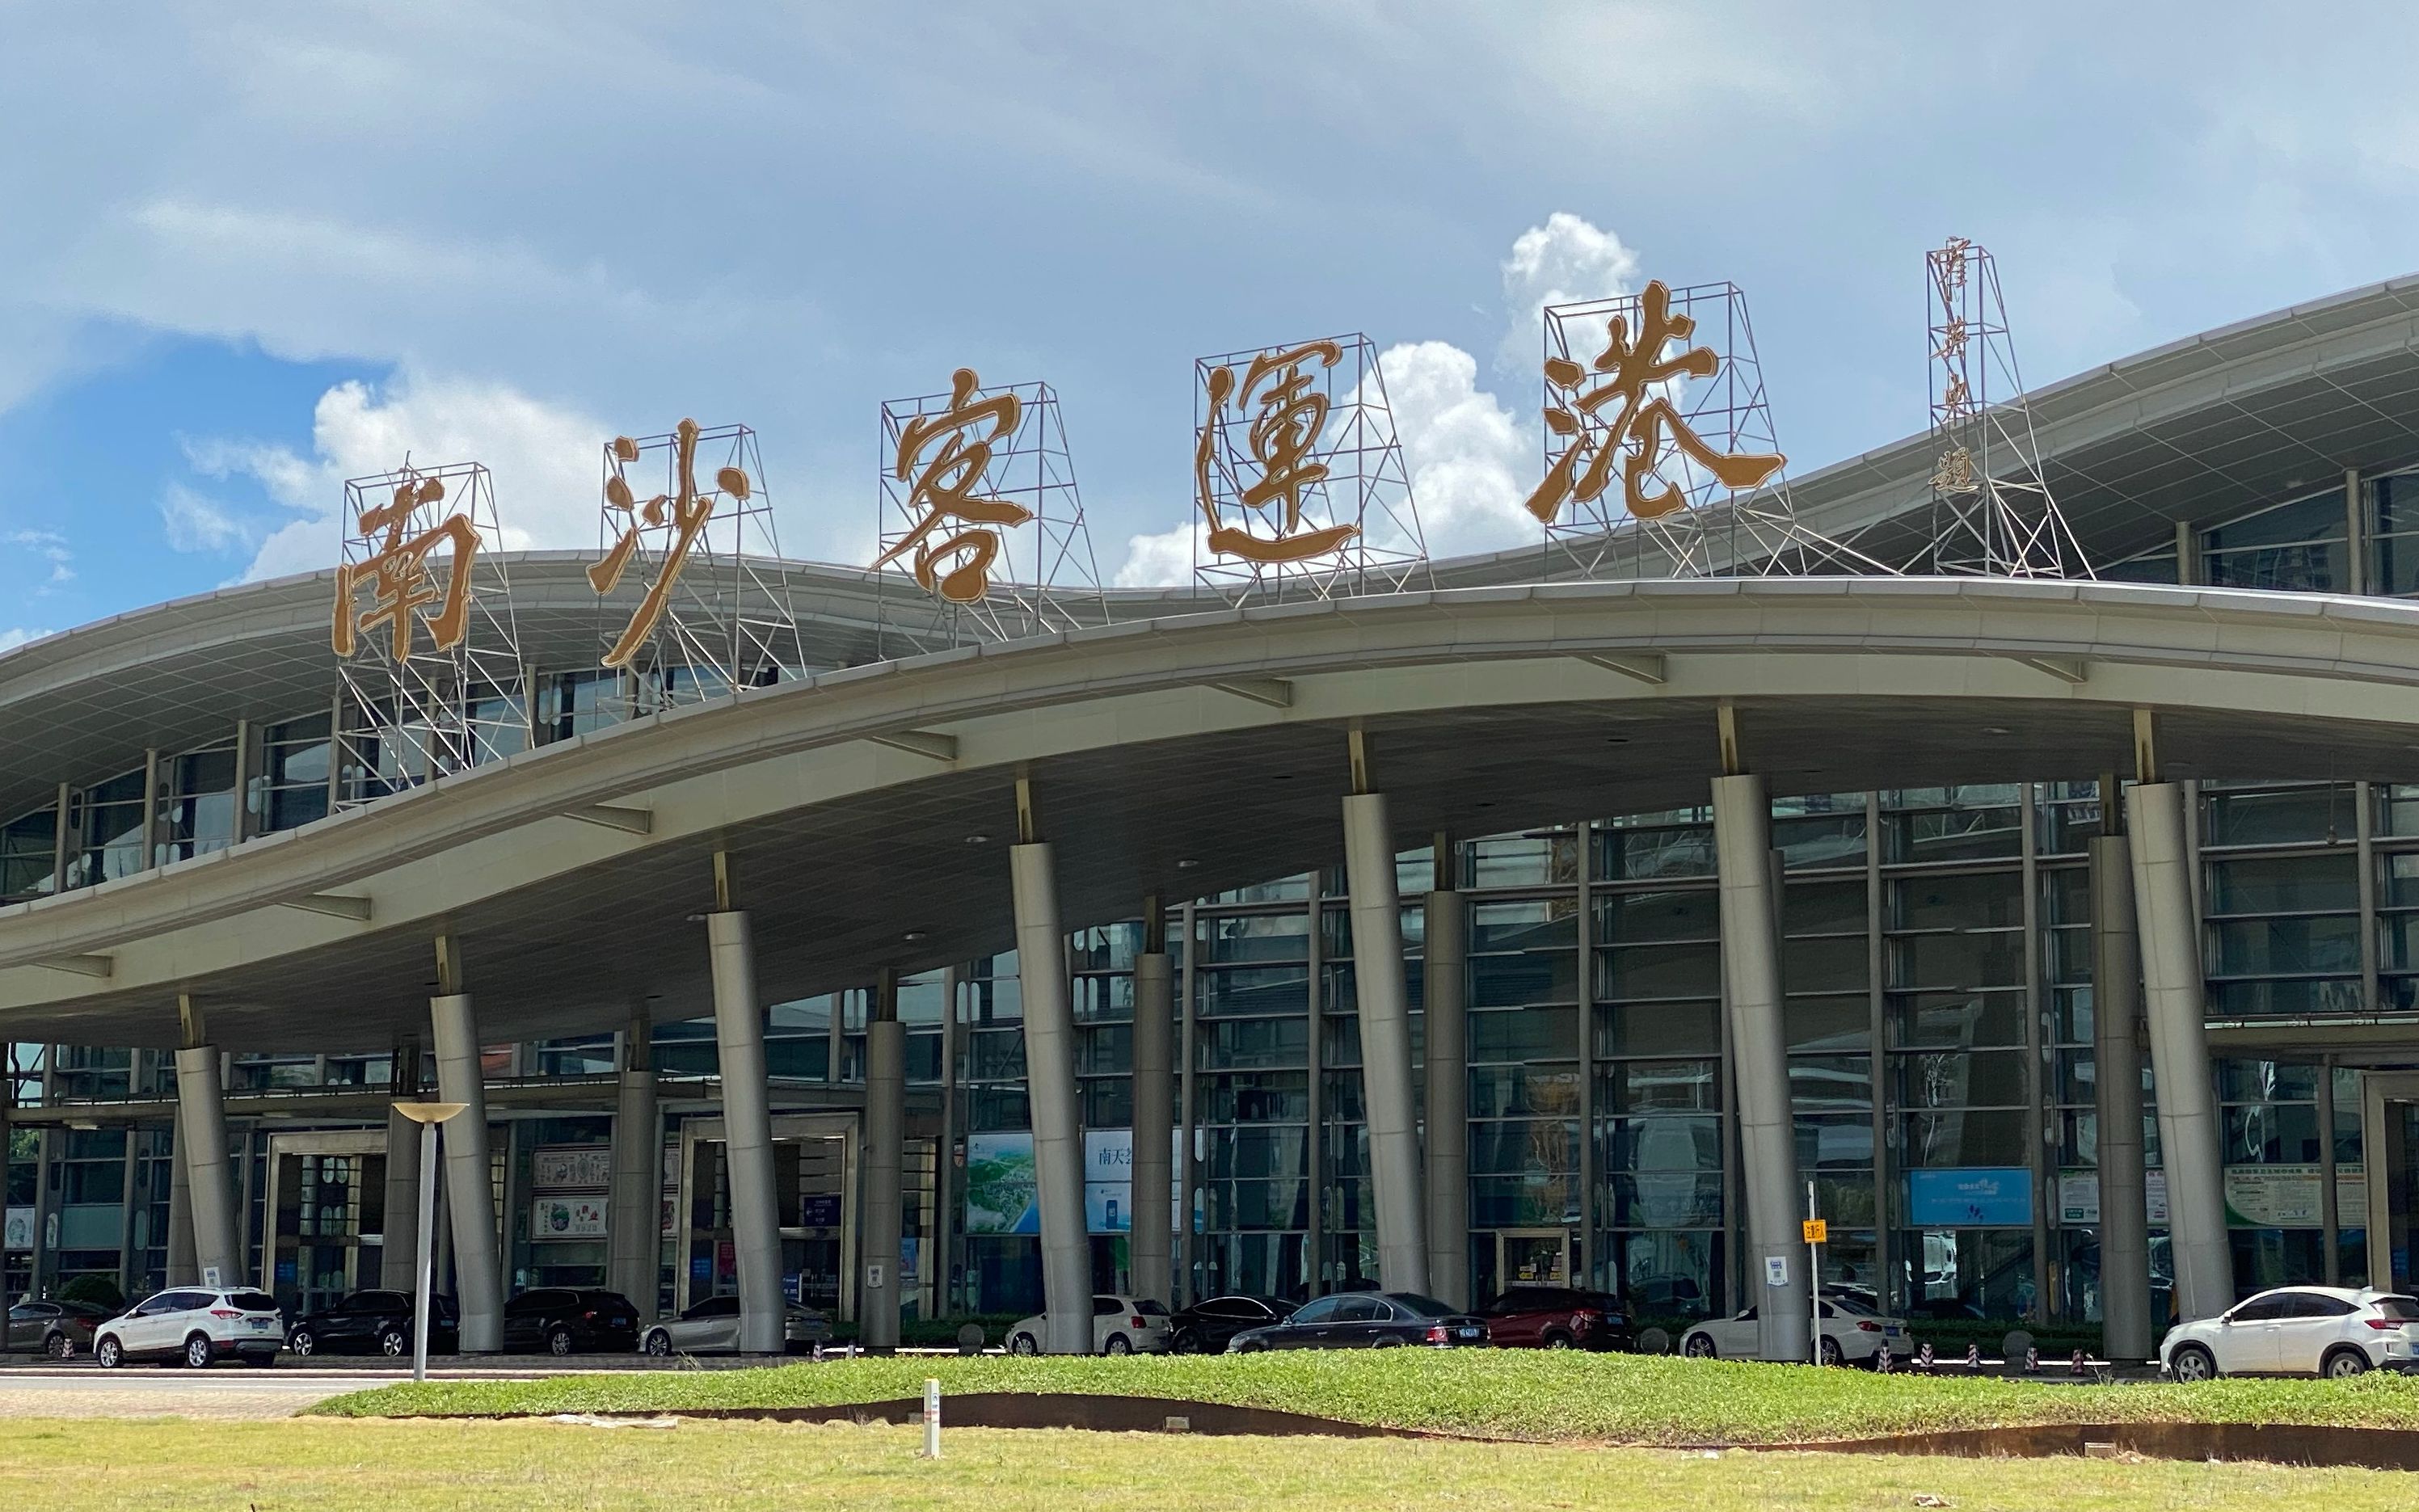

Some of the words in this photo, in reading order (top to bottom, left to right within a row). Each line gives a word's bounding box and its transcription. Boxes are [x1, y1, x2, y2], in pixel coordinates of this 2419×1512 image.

[332, 280, 1788, 668] 南沙客運港
